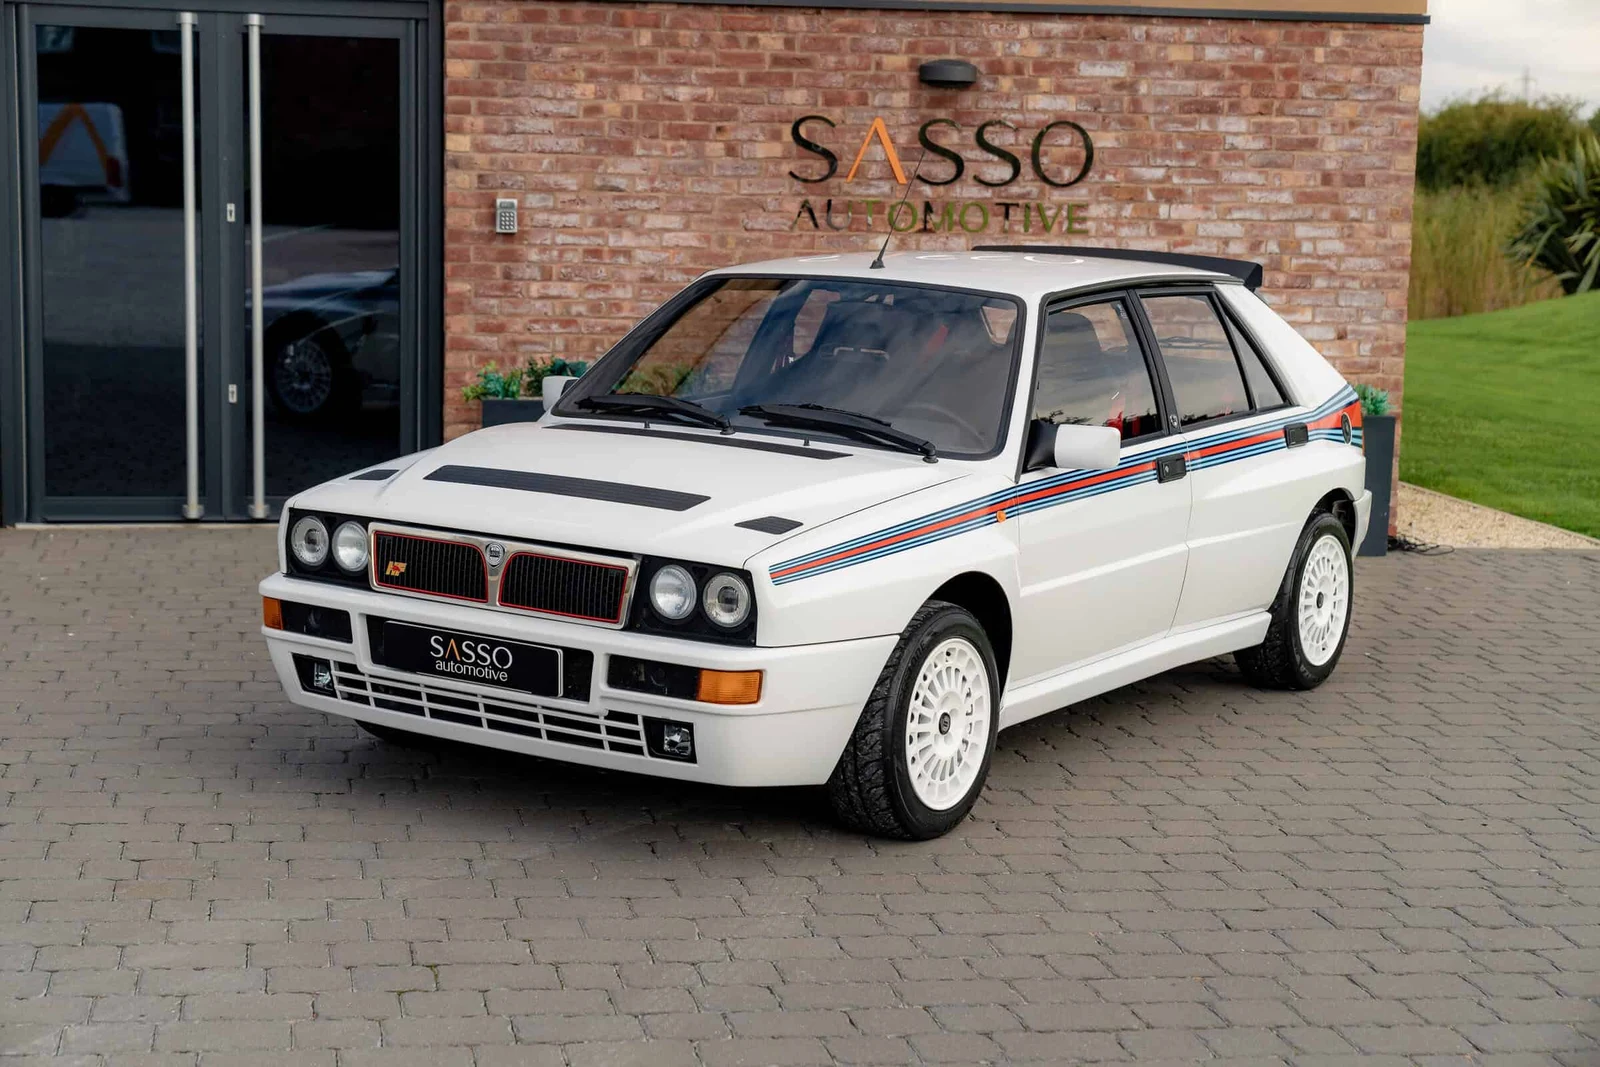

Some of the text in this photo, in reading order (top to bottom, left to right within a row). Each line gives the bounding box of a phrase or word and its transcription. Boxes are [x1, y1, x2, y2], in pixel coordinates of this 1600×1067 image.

[788, 115, 1094, 187] SASSO
[791, 199, 1089, 233] AUTOMOTIVE
[430, 635, 513, 669] SASSO
[435, 659, 508, 682] automotive
